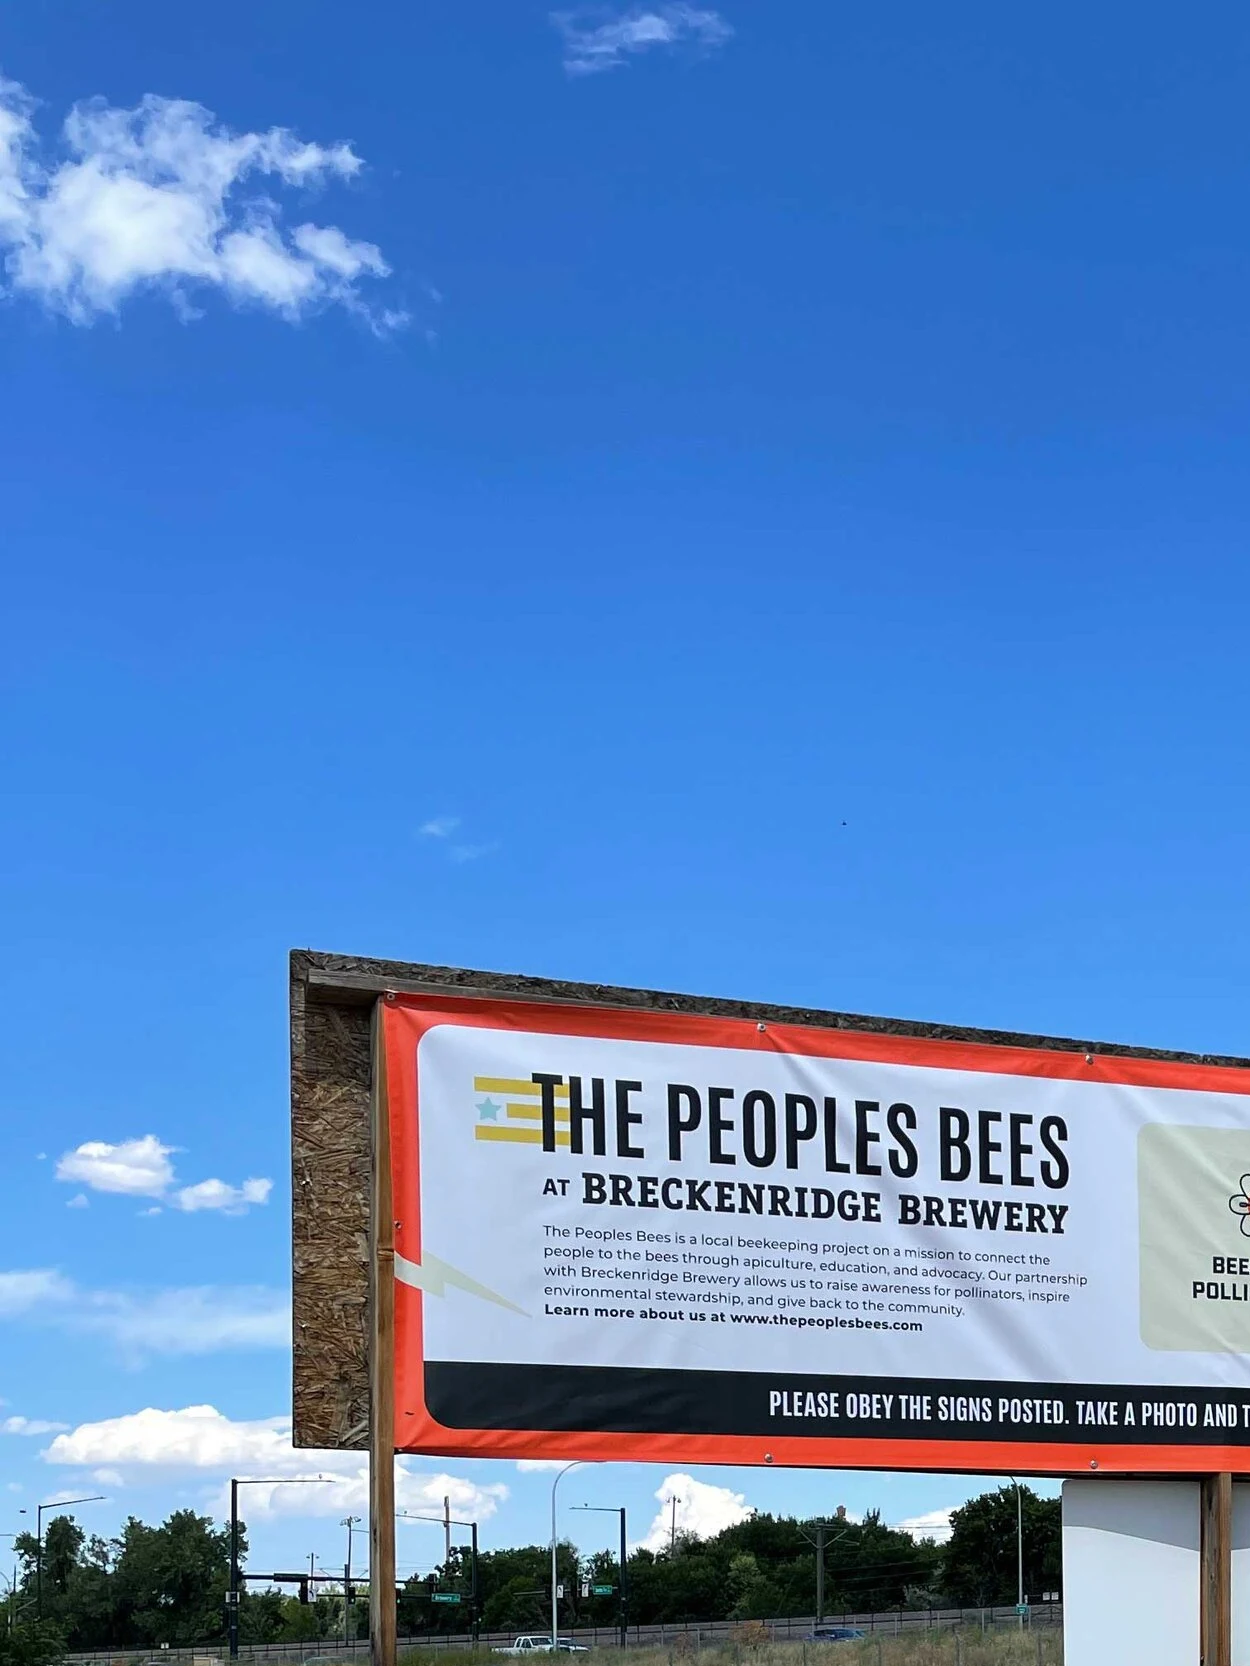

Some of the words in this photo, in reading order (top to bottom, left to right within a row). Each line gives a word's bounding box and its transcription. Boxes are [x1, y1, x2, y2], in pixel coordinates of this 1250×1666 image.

[532, 1073, 644, 1159] THE
[667, 1084, 918, 1178] PEOPLES
[940, 1109, 1069, 1189] BEES
[543, 1178, 570, 1196] AT
[582, 1172, 881, 1222] BRECKENRIDGE
[898, 1194, 1068, 1234] BREWERY
[543, 1225, 570, 1237] The
[575, 1227, 632, 1242] Peoples
[637, 1230, 671, 1243] Bees
[675, 1232, 686, 1244] is
[689, 1236, 697, 1245] a
[701, 1234, 733, 1247] local
[738, 1236, 818, 1254] beekeeping
[823, 1242, 869, 1256] project
[873, 1247, 889, 1256] on
[893, 1248, 901, 1257] a
[905, 1248, 954, 1260] mission
[958, 1251, 971, 1261] to
[974, 1253, 1026, 1264] connect
[1029, 1254, 1050, 1265] the
[544, 1246, 594, 1260] people
[598, 1249, 613, 1259] to
[616, 1249, 641, 1261] the
[645, 1250, 679, 1263] bees
[682, 1252, 739, 1268] through
[743, 1257, 816, 1272] apiculture,
[819, 1261, 890, 1276] education,
[893, 1265, 918, 1276] and
[921, 1267, 985, 1282] advocacy.
[988, 1270, 1012, 1281] Our
[1015, 1273, 1087, 1287] partnership
[544, 1265, 576, 1277] with
[581, 1266, 678, 1284] Breckenridge
[683, 1272, 740, 1288] Brewery
[744, 1275, 787, 1288] allows
[791, 1280, 806, 1288] us
[809, 1279, 823, 1289] to
[827, 1279, 858, 1291] raise
[862, 1283, 931, 1295] awareness
[934, 1285, 951, 1296] for
[955, 1286, 1025, 1302] pollinators,
[1028, 1292, 1070, 1304] inspire
[544, 1286, 651, 1300] environmental
[655, 1290, 744, 1306] stewardship,
[747, 1295, 773, 1306] and
[777, 1295, 806, 1309] give
[810, 1297, 842, 1309] back
[845, 1300, 859, 1310] to
[862, 1299, 884, 1311] the
[888, 1303, 965, 1317] community.
[545, 1304, 589, 1316] Learn
[594, 1308, 635, 1318] more
[640, 1308, 684, 1320] about
[689, 1312, 706, 1321] us
[711, 1312, 726, 1322] at
[730, 1314, 922, 1331] www.thepeoplesbees.com
[770, 1391, 839, 1417] PLEASE
[846, 1393, 894, 1419] OBEY
[898, 1395, 931, 1420] THE
[938, 1396, 992, 1422] SIGNS
[999, 1398, 1069, 1424] POSTED.
[1076, 1401, 1118, 1425] TAKE
[1124, 1402, 1135, 1426] A
[1142, 1402, 1197, 1426] PHOTO
[1203, 1403, 1237, 1427] AND
